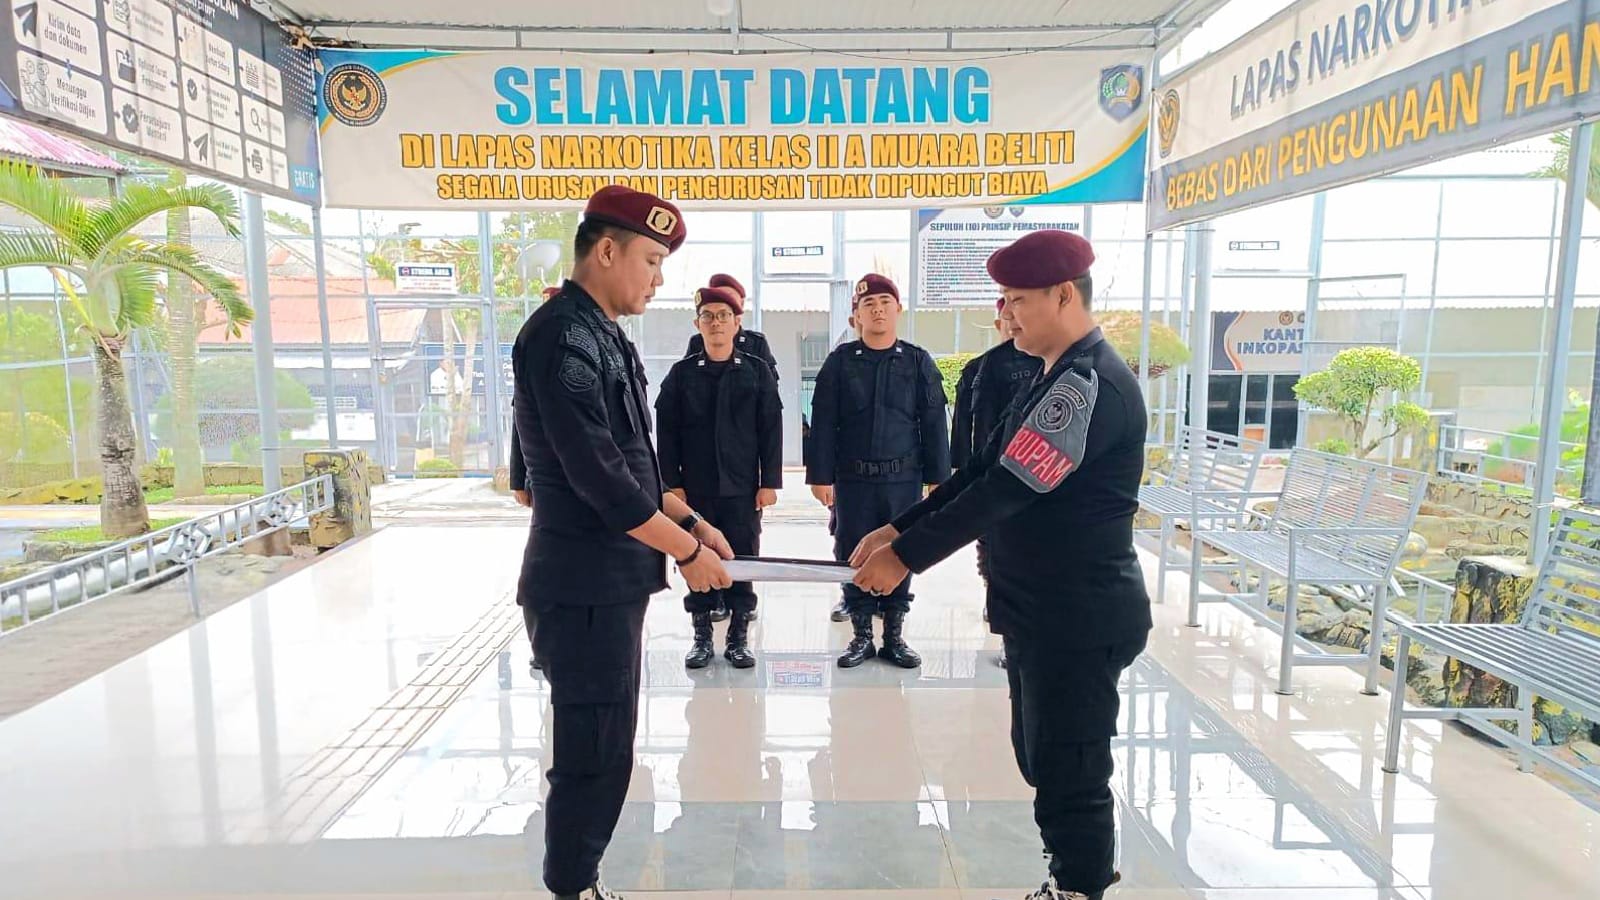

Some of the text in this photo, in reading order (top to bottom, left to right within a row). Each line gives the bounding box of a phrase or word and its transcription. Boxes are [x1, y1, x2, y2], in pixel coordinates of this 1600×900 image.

[44, 26, 87, 55] dan dokumen
[66, 21, 81, 39] data
[494, 66, 991, 126] SELAMAT DATANG
[1230, 41, 1301, 120] LAPAS
[401, 130, 1075, 170] DI LAPAS NARKOTIKA KELAS II A MUARA BELITI
[1166, 161, 1220, 213] BEBAS
[1223, 142, 1273, 197] DARI
[1277, 64, 1484, 181] PENGUNAAN
[437, 175, 519, 201] SEGALA
[661, 174, 804, 200] PENGURUSAN
[808, 174, 873, 200] TIDAK
[876, 172, 984, 198] DIPUNGUT
[987, 170, 1048, 196] BIAYA
[929, 222, 964, 232] SEPULUH
[981, 222, 1012, 231] PRINSIP
[1004, 429, 1073, 488] RUPAM
